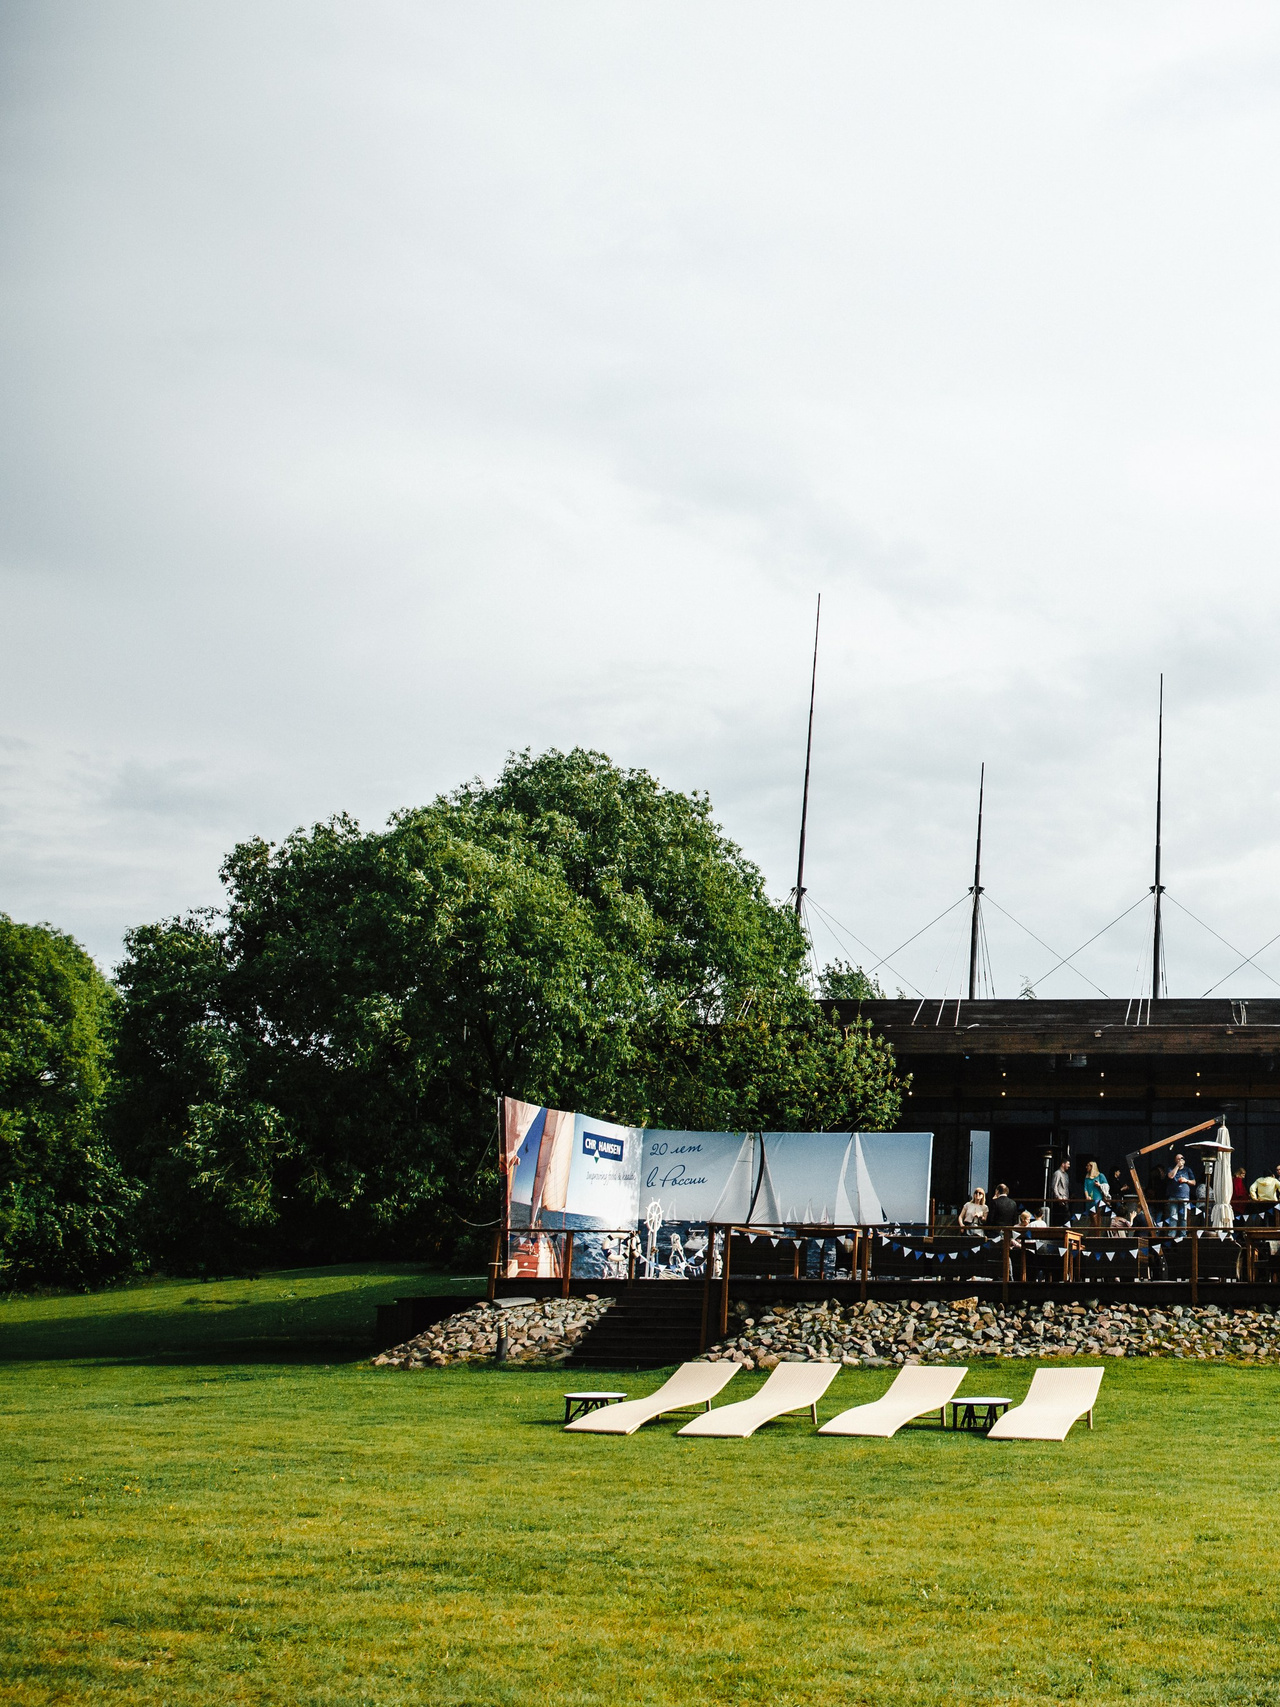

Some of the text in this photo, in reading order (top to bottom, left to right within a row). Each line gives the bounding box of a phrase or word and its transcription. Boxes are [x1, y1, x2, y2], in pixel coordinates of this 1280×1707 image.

[599, 1141, 621, 1155] HANSEN
[650, 1143, 703, 1156] 20 лет
[647, 1164, 707, 1187] в России
